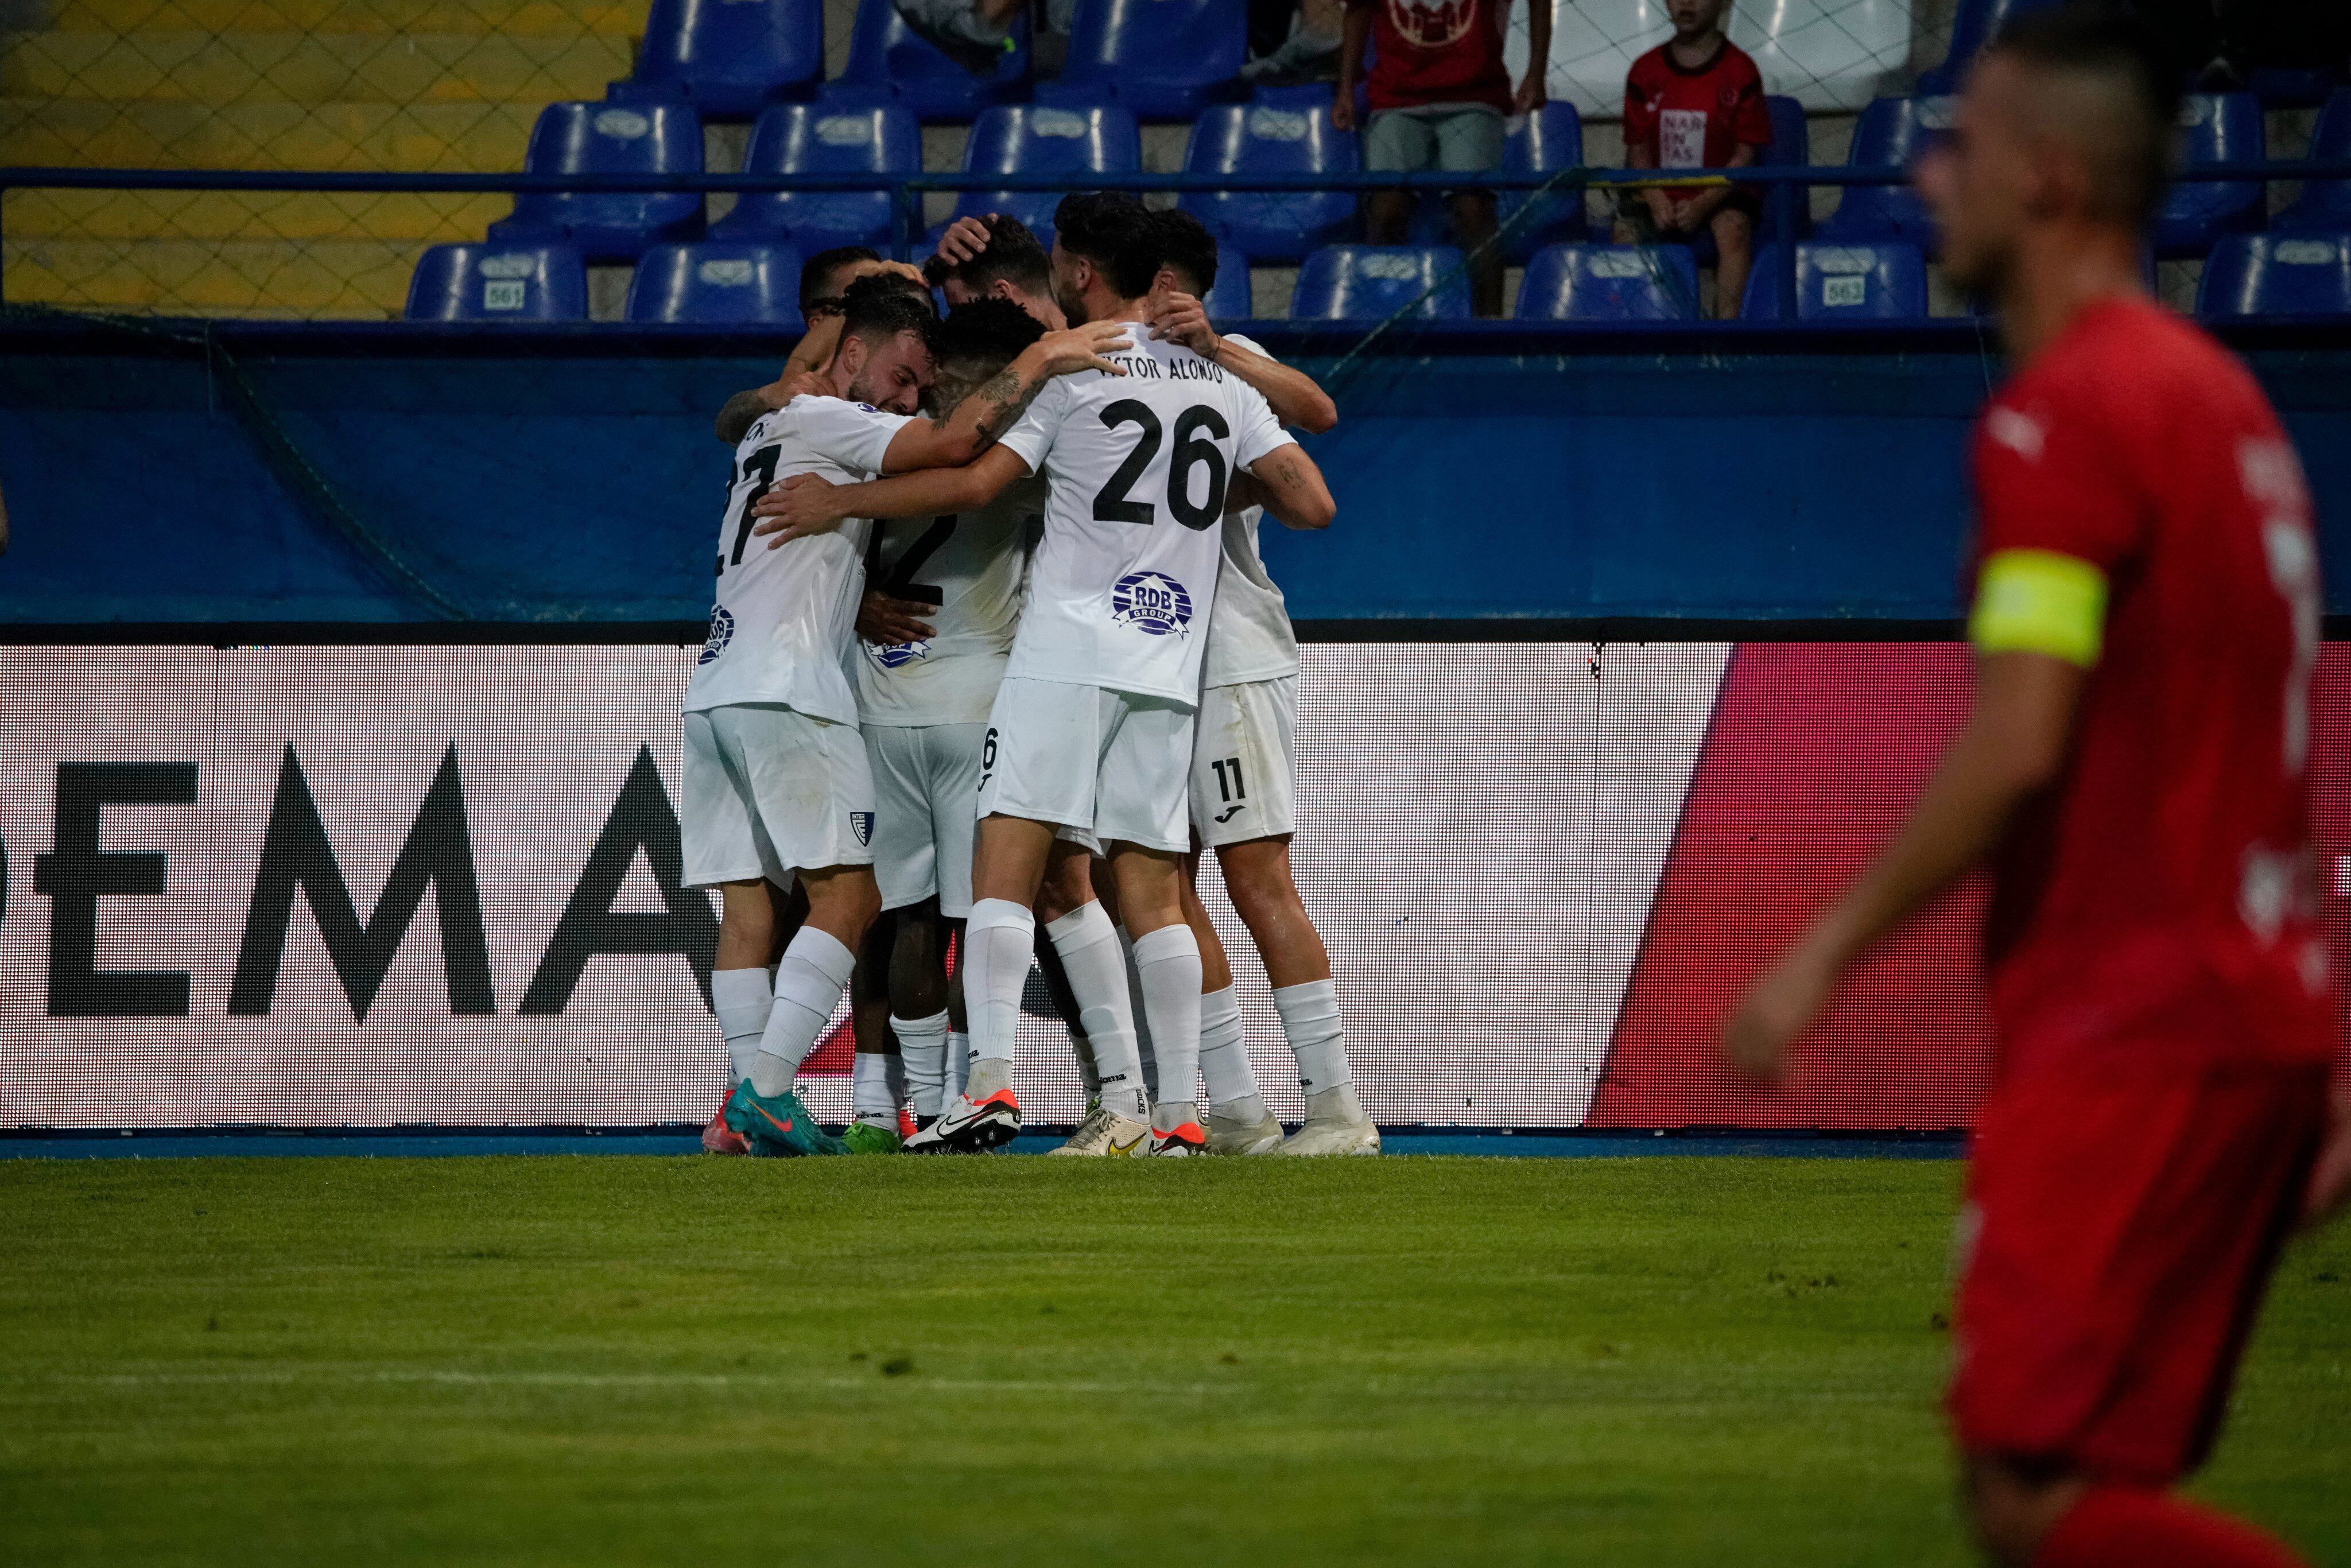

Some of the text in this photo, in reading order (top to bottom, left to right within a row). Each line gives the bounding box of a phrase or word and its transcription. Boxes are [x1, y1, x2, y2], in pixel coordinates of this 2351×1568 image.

[1170, 358, 1223, 384] ALONSO
[1093, 399, 1231, 531] 26
[1134, 609, 1171, 620] GROUP
[1135, 586, 1172, 610] RDB
[979, 728, 998, 773] 6
[1212, 757, 1246, 802] 11
[0, 740, 720, 1025] EMA
[1136, 1089, 1146, 1115] SOCKS
